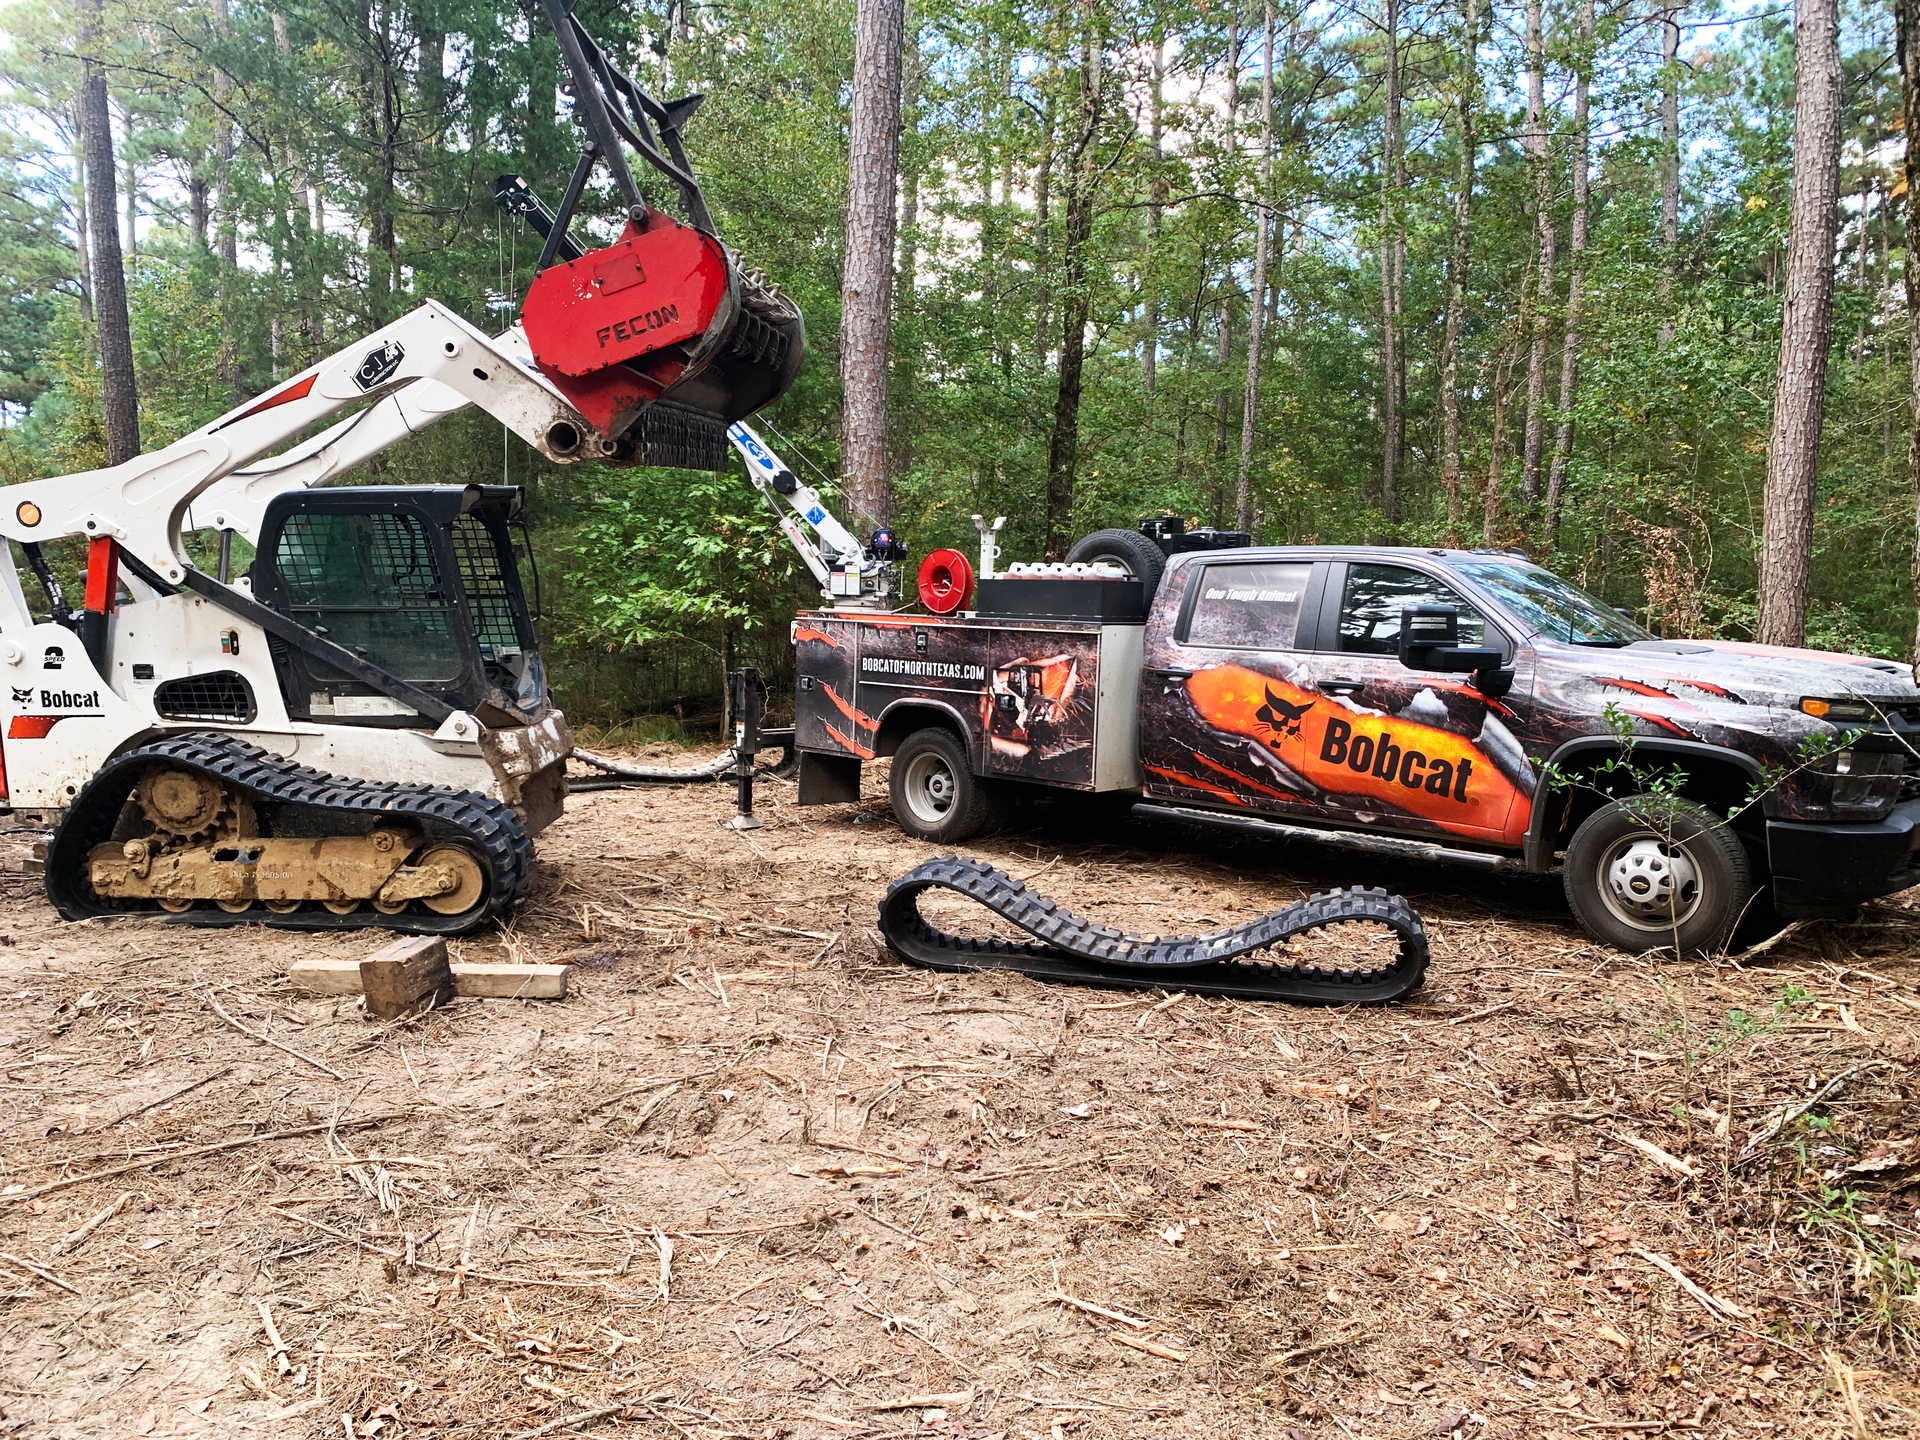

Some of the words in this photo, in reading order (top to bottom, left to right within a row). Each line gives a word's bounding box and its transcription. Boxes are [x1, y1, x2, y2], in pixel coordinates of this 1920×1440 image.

[596, 304, 679, 349] FECON
[1205, 588, 1226, 600] One
[1225, 588, 1258, 602] Tough
[1256, 589, 1298, 603] Animal
[43, 646, 64, 669] 2
[862, 657, 985, 680] BOBCATOFNORTHTEXAS.COM
[40, 690, 100, 708] Bobcat
[1319, 717, 1472, 803] Bobcat
